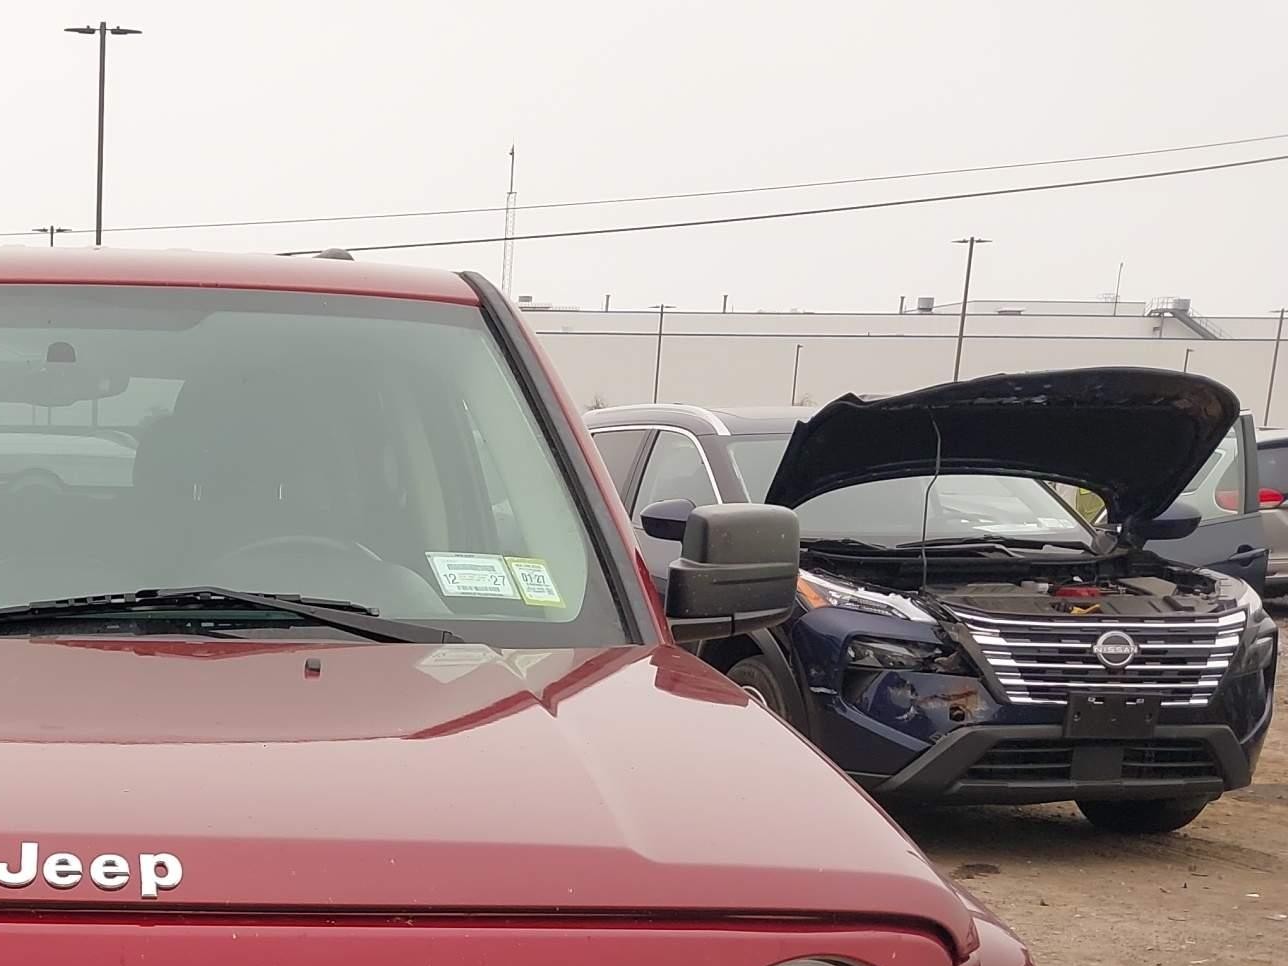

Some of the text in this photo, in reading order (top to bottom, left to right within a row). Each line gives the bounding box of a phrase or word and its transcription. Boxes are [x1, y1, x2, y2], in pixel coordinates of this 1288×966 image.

[443, 573, 460, 585] 12
[490, 574, 506, 586] 27
[1094, 646, 1138, 654] NISSAN
